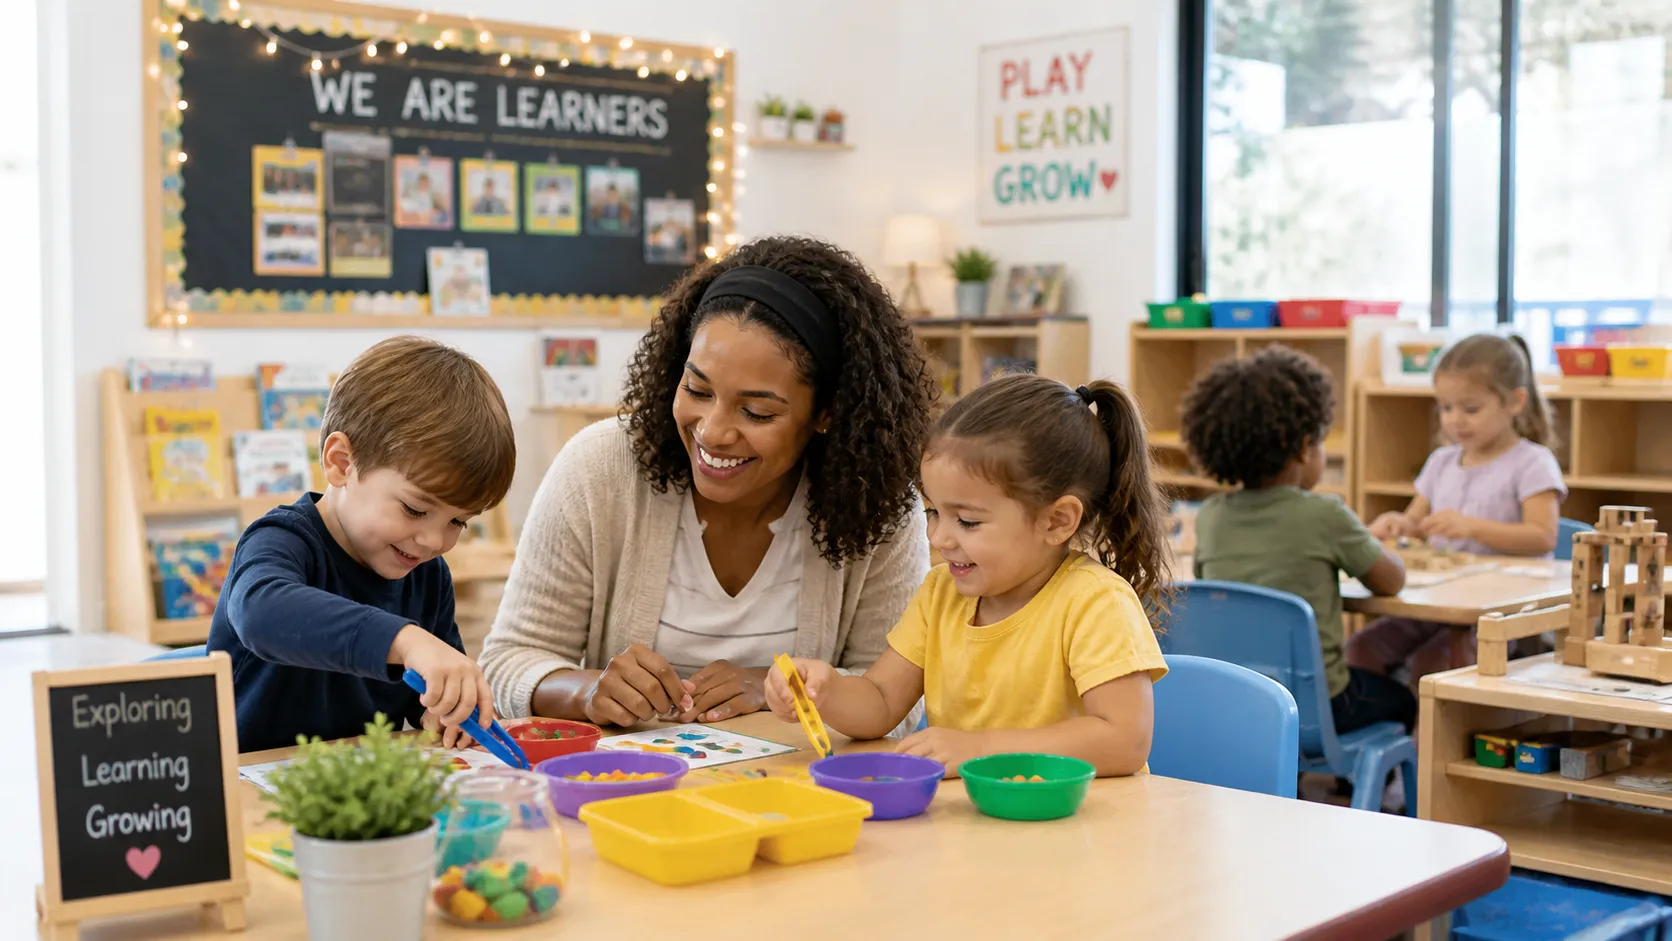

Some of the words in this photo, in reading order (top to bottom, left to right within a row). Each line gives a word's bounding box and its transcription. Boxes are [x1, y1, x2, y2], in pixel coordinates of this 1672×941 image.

[1000, 50, 1093, 100] PLAY
[309, 70, 378, 117] WE
[401, 76, 479, 124] ARE
[496, 84, 669, 140] LEARNERS
[995, 103, 1111, 153] LEARN
[993, 159, 1096, 205] GROW
[72, 692, 192, 738] Exploring
[81, 752, 190, 792] Learning
[85, 803, 192, 843] Growing
